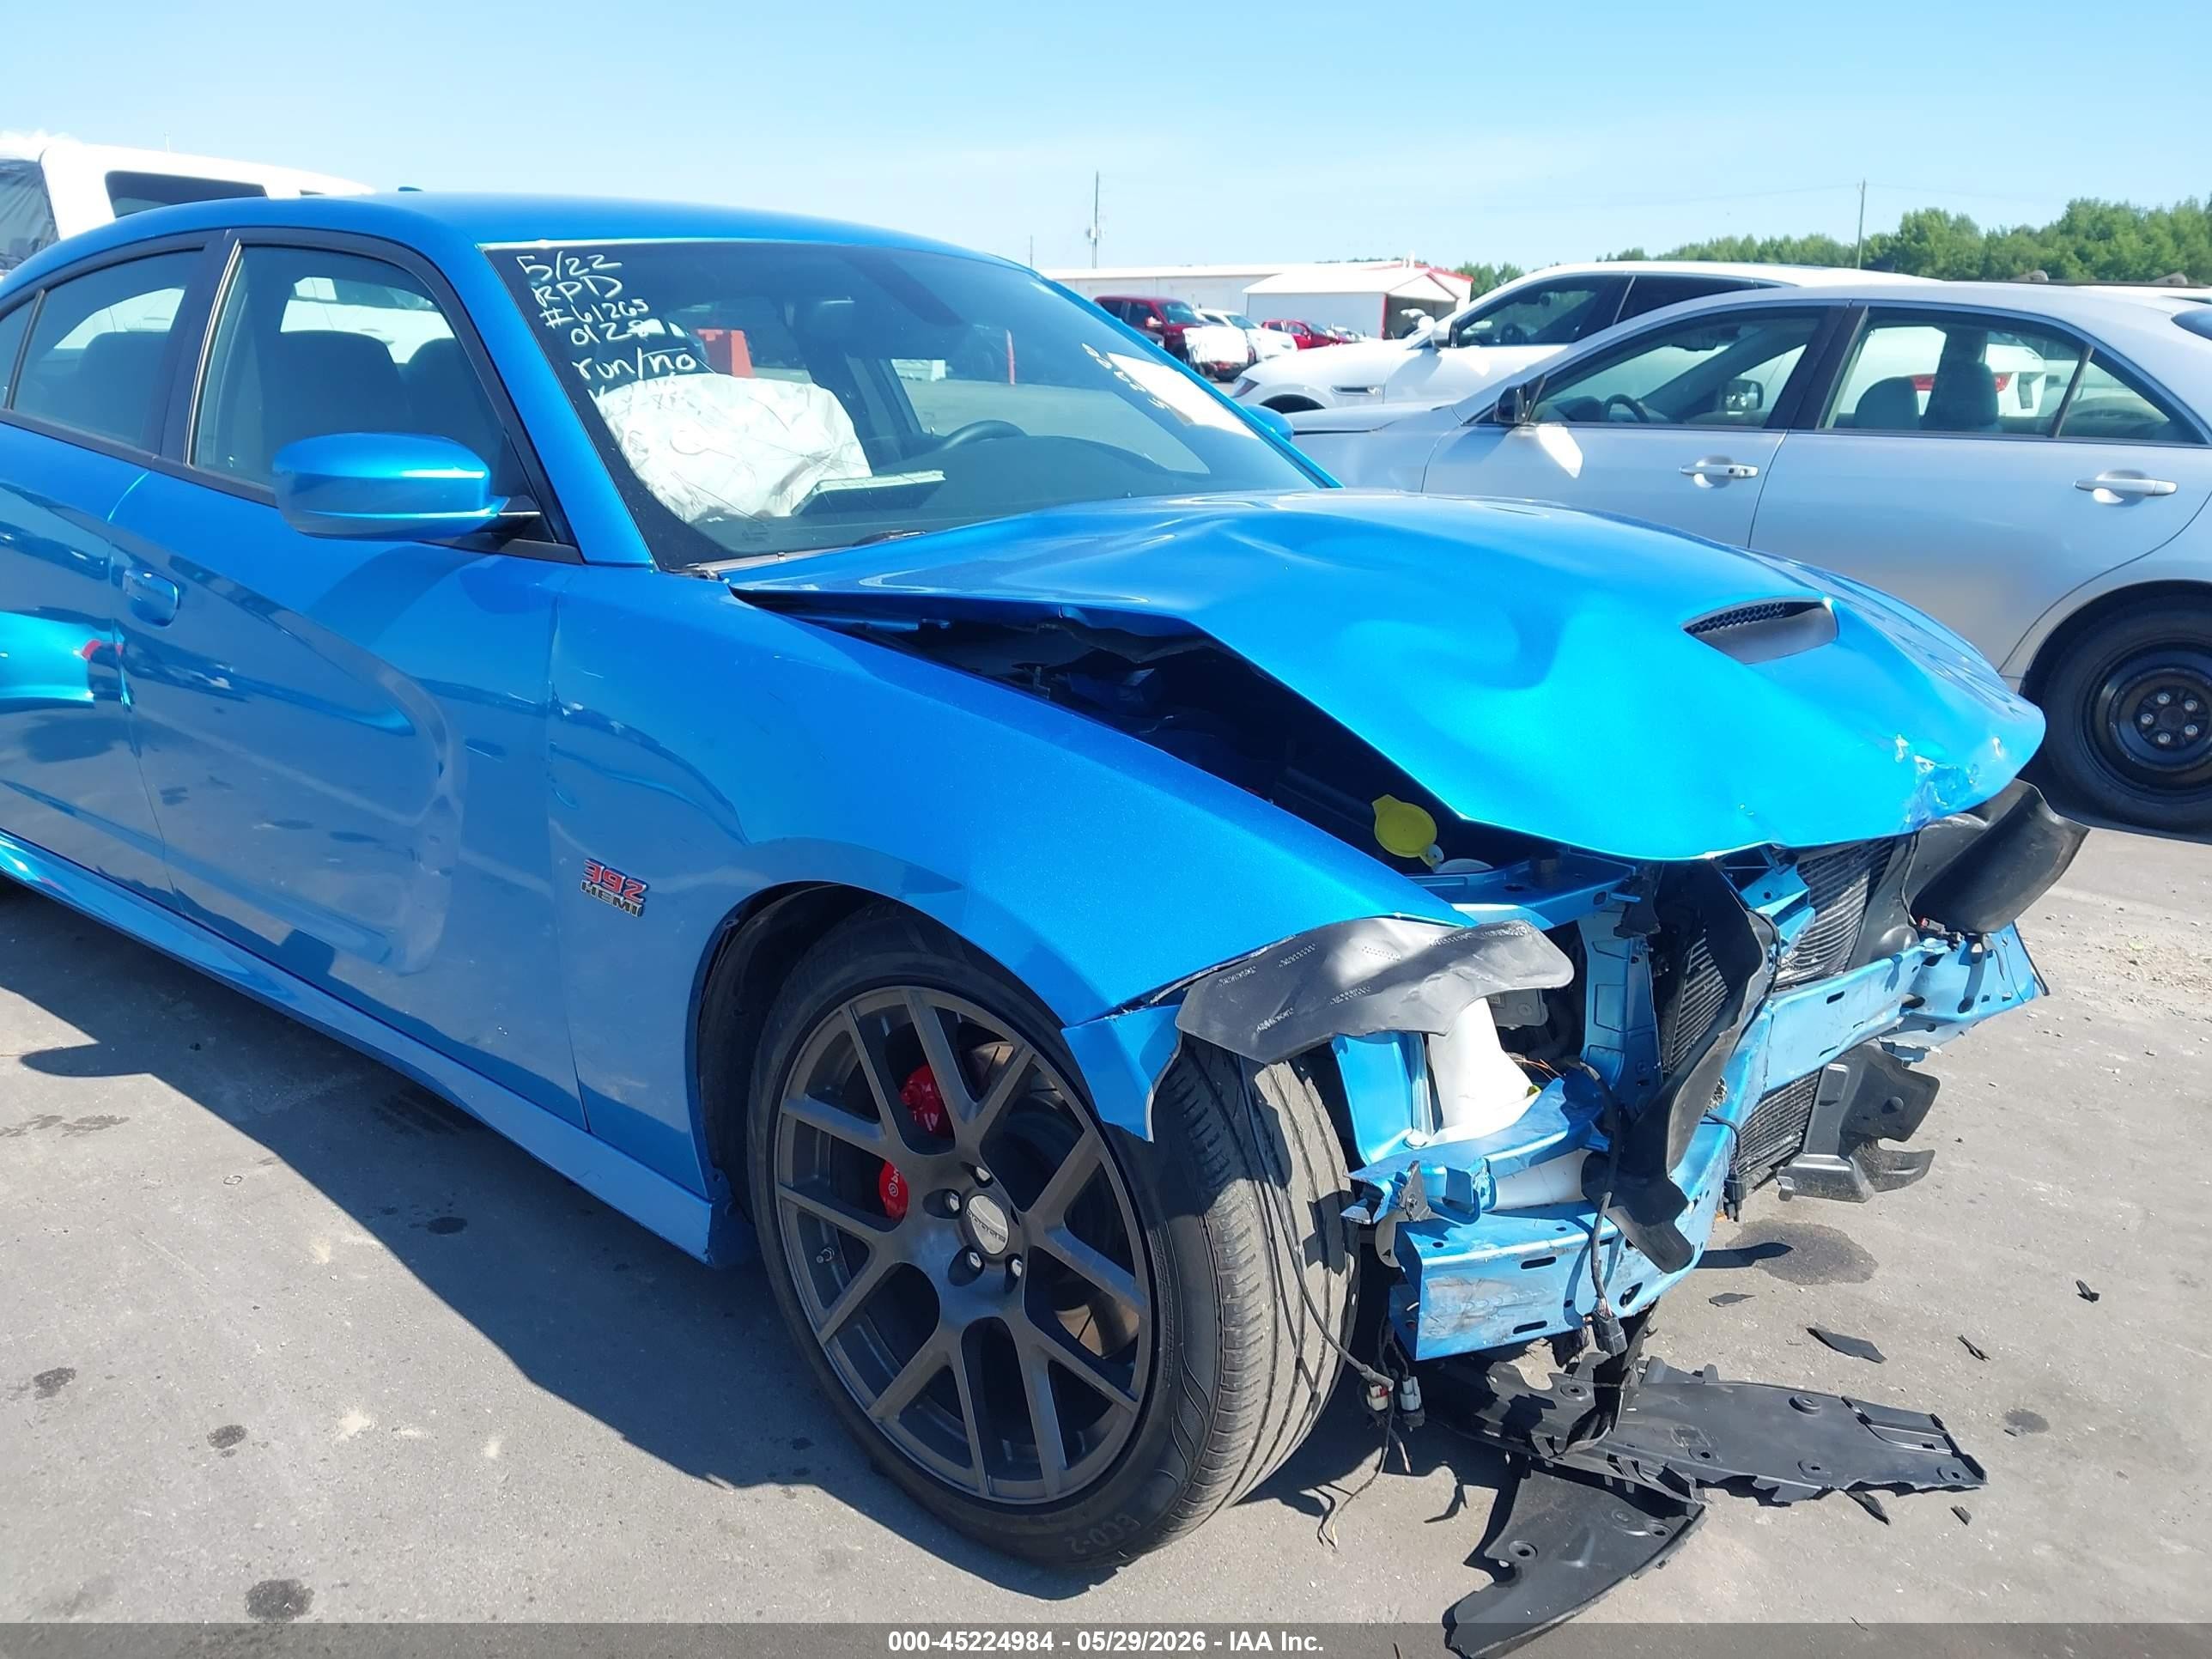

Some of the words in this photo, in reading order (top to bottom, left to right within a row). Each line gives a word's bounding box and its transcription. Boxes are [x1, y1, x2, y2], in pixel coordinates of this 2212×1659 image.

[516, 251, 623, 281] 5/22
[532, 275, 623, 307] RPD
[580, 879, 643, 918] HEMI
[583, 859, 647, 903] 392
